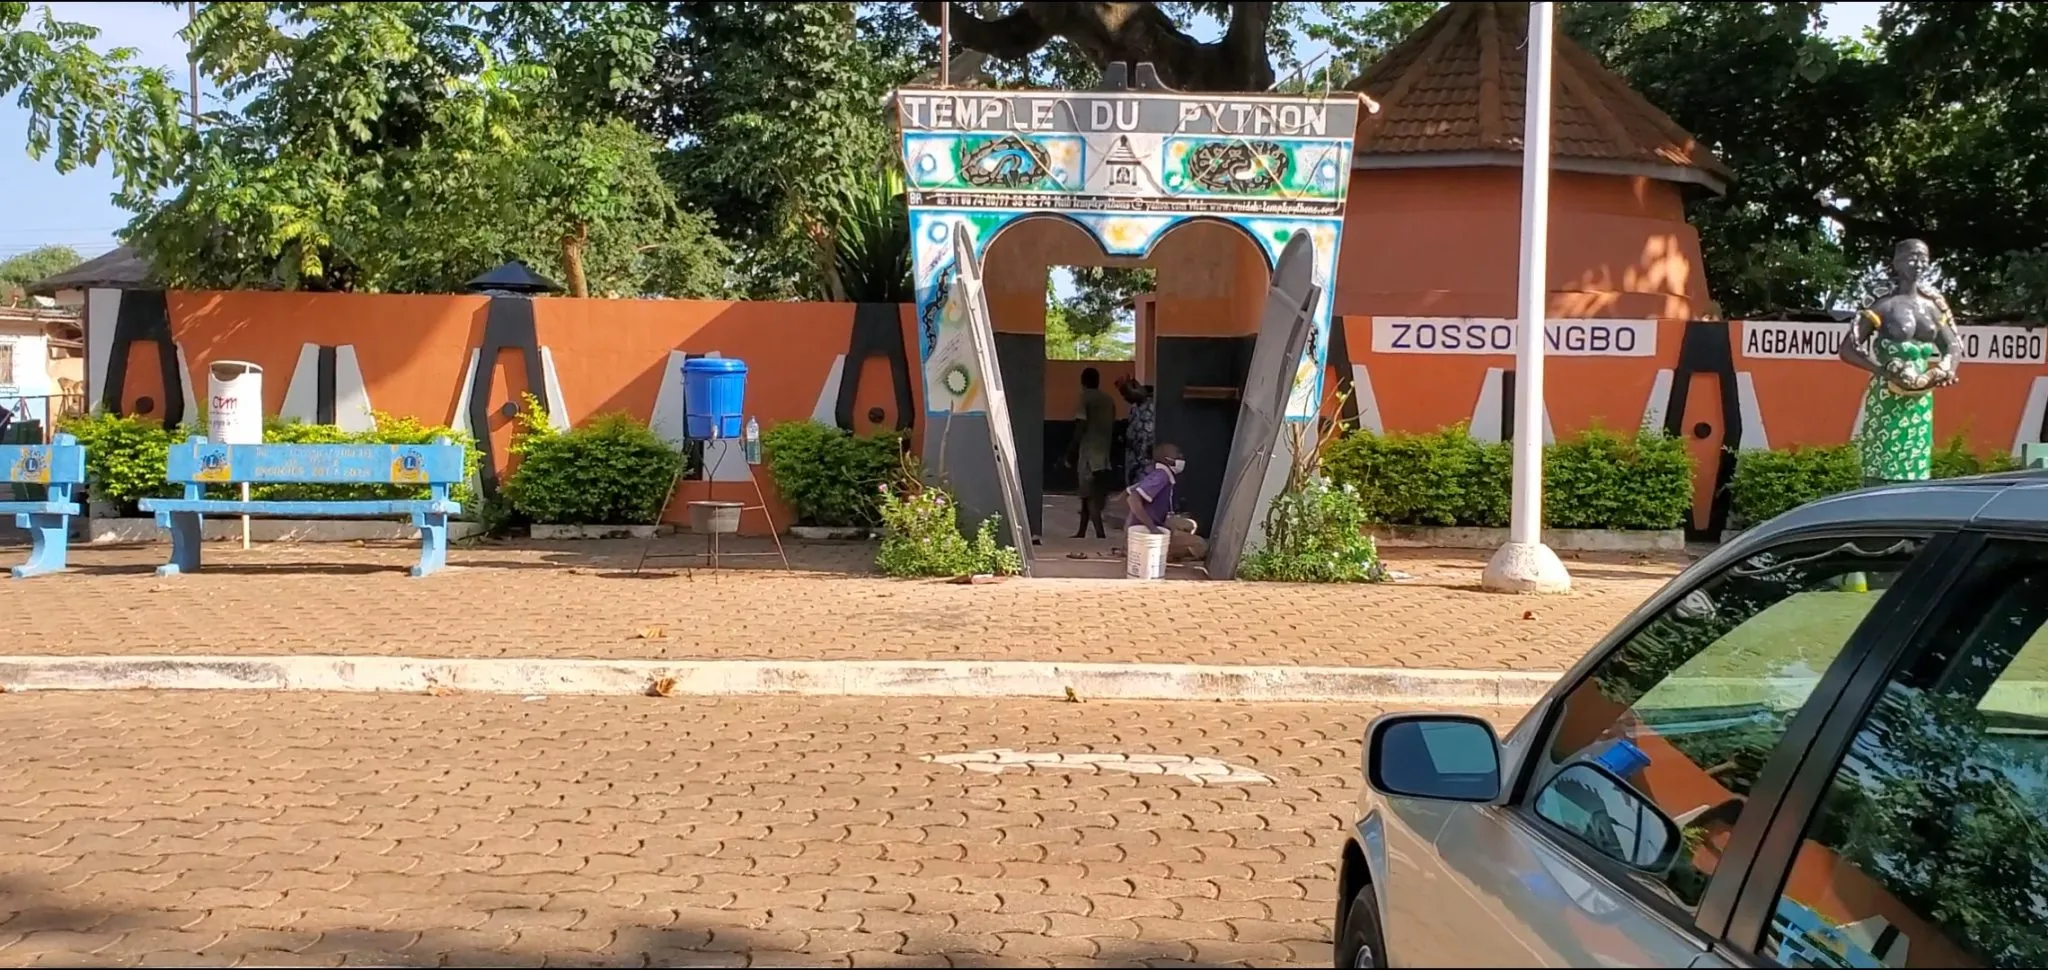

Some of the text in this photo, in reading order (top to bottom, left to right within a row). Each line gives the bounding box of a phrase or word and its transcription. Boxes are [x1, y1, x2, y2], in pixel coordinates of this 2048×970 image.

[904, 97, 1327, 135] TEMPLE DU PYTHON
[1391, 324, 1636, 351] ZOSSONGBO
[1748, 328, 1841, 355] AGBAMOU
[1988, 334, 2041, 360] AGBO
